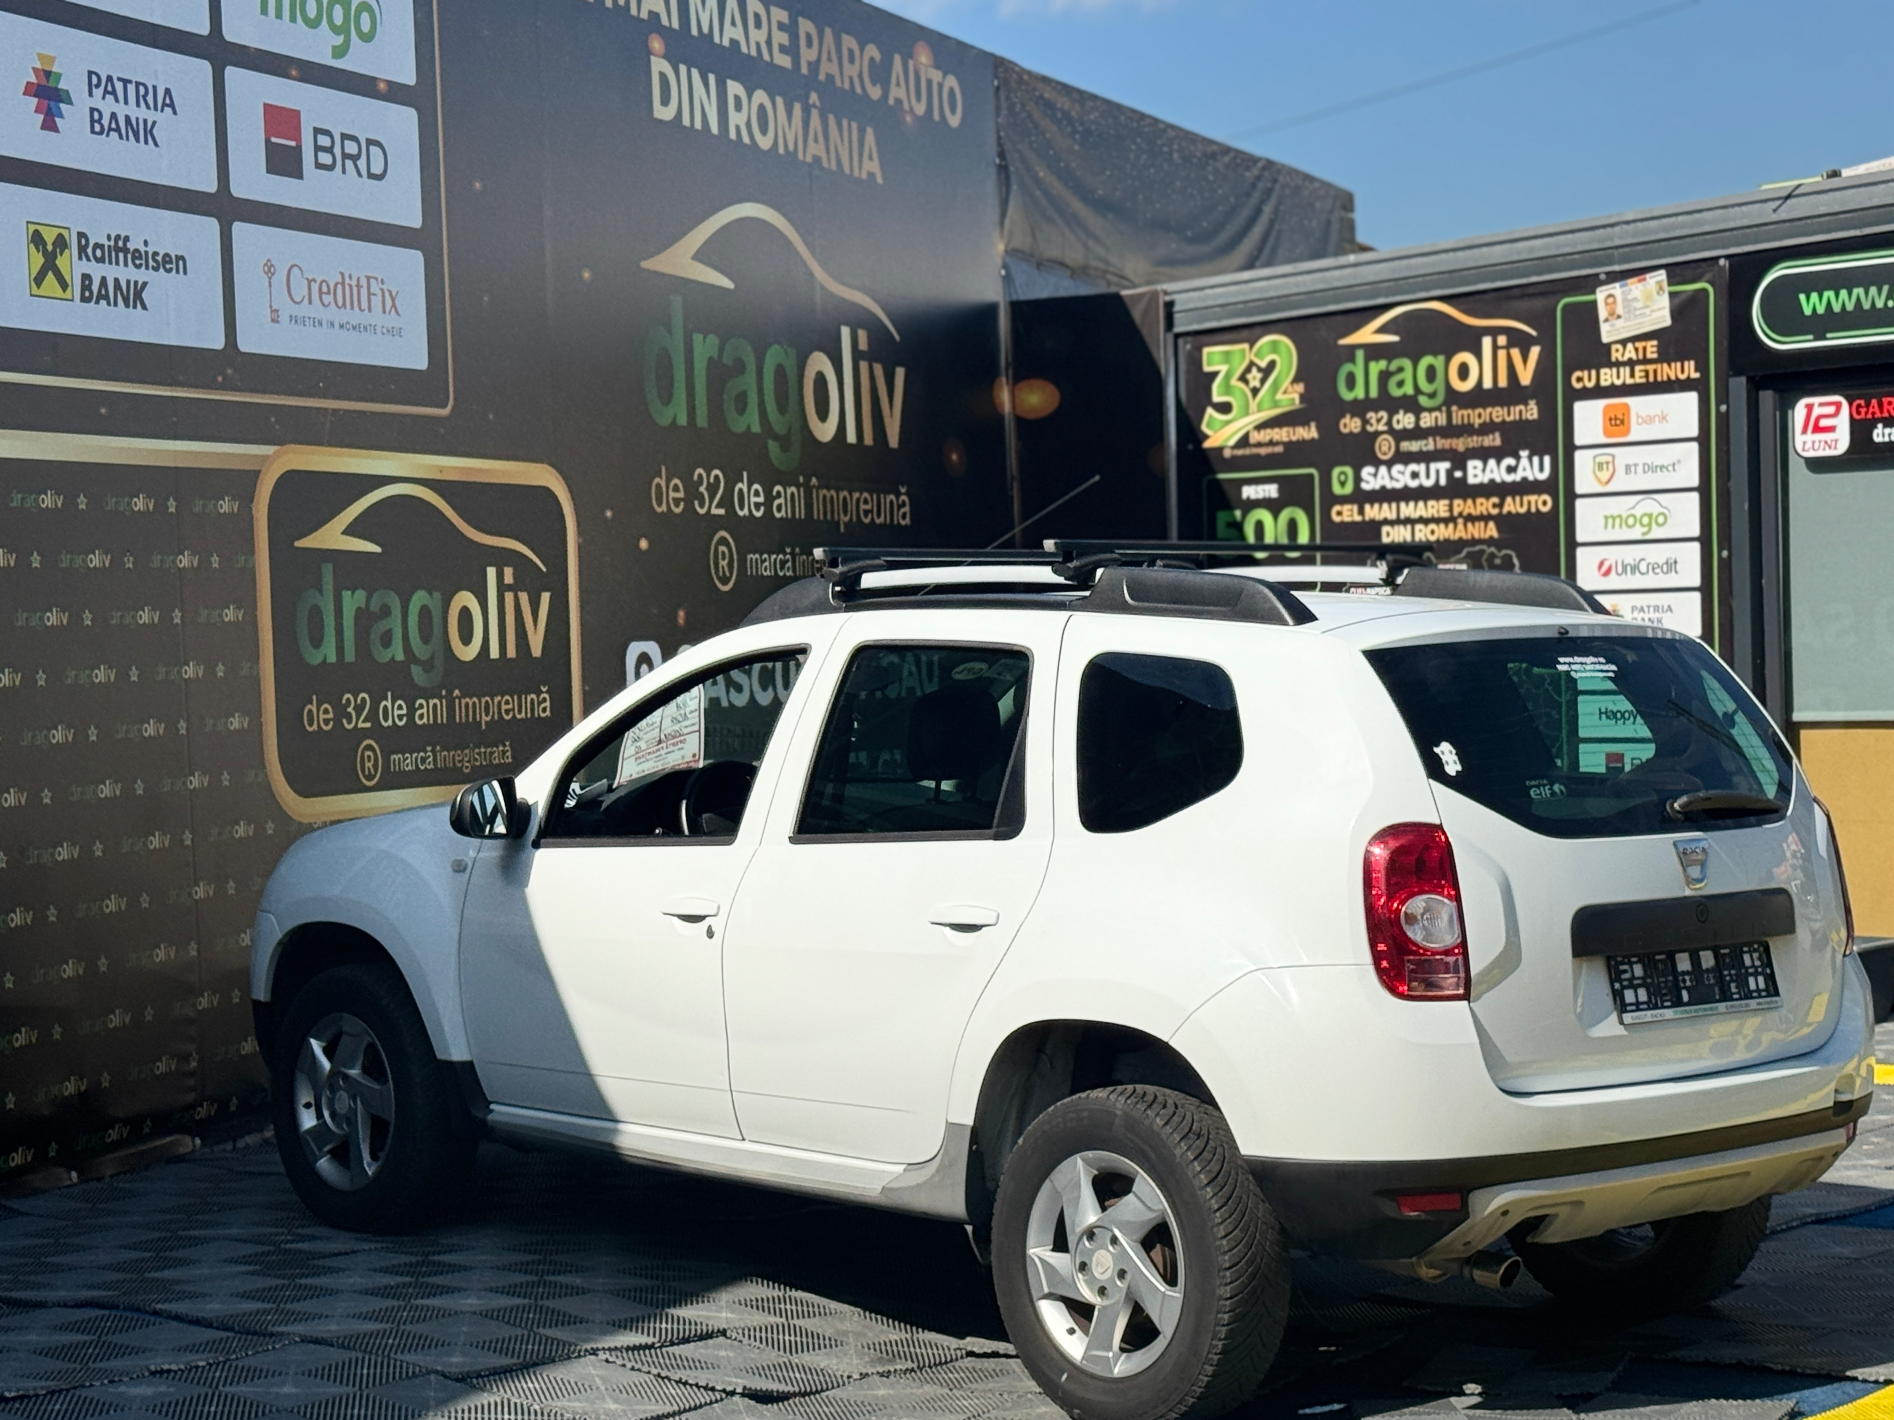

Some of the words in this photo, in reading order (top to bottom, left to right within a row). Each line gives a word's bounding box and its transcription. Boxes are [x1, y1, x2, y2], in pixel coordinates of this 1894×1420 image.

[689, 0, 792, 70] MARE
[798, 16, 883, 101] PARC
[888, 53, 963, 129] AUTO
[87, 70, 177, 115] PATRIA
[89, 107, 159, 147] BANK
[650, 55, 719, 136] DIN
[726, 78, 884, 185] ROMÂNIA
[313, 127, 388, 181] BRD
[77, 232, 187, 275] Raiffeisen
[80, 273, 148, 311] BANK
[286, 263, 401, 316] CreditFix
[1799, 284, 1894, 316] www.
[289, 314, 323, 328] PRIETEN
[327, 319, 335, 329] IN
[339, 321, 377, 334] MOMENTE
[381, 325, 403, 338] CHEIE
[1611, 340, 1658, 362] RATE
[643, 295, 906, 472] dragoliv
[1201, 333, 1298, 437] 32
[1336, 335, 1542, 409] dragoliv
[1571, 369, 1596, 390] CU
[1600, 360, 1701, 387] BULETINUL
[1249, 421, 1319, 444] ÎMPREUNĂ
[1339, 413, 1362, 434] de
[1365, 410, 1388, 432] 32
[1392, 409, 1416, 431] de
[1419, 406, 1447, 428] ani
[1450, 399, 1539, 429] împreună
[1608, 412, 1625, 427] tbi
[1636, 410, 1669, 426] bank
[1801, 401, 1842, 435] 12
[1399, 435, 1435, 453] marcă
[1436, 431, 1502, 452] înregistrată
[1802, 439, 1839, 452] LUNI
[1360, 461, 1451, 492] SASCUT
[1467, 450, 1551, 486] BACĂU
[1597, 461, 1611, 473] BT
[1625, 463, 1639, 475] BT
[651, 465, 685, 514] de
[693, 467, 726, 516] 32
[734, 471, 765, 518] de
[772, 476, 805, 520] ani
[810, 477, 911, 533] împreună
[1241, 483, 1279, 500] PESTE
[1330, 504, 1362, 523] CEL
[1364, 502, 1398, 521] MAI
[1400, 499, 1450, 520] MARE
[1453, 496, 1500, 517] PARC
[1502, 494, 1553, 515] AUTO
[1603, 511, 1668, 536] mogo
[1381, 524, 1412, 544] DIN
[1414, 518, 1499, 542] ROMÂNIA
[746, 546, 794, 577] marcă
[1615, 557, 1678, 577] UniCredit
[296, 562, 551, 688] dragoliv
[1631, 604, 1673, 616] PATRIA
[304, 696, 334, 732] de
[342, 692, 372, 729] 32
[379, 691, 407, 728] de
[415, 691, 447, 724] ani
[453, 685, 551, 730] împreună
[1598, 707, 1638, 725] Happy
[390, 746, 434, 773] marcă
[436, 741, 513, 773] înregistrată
